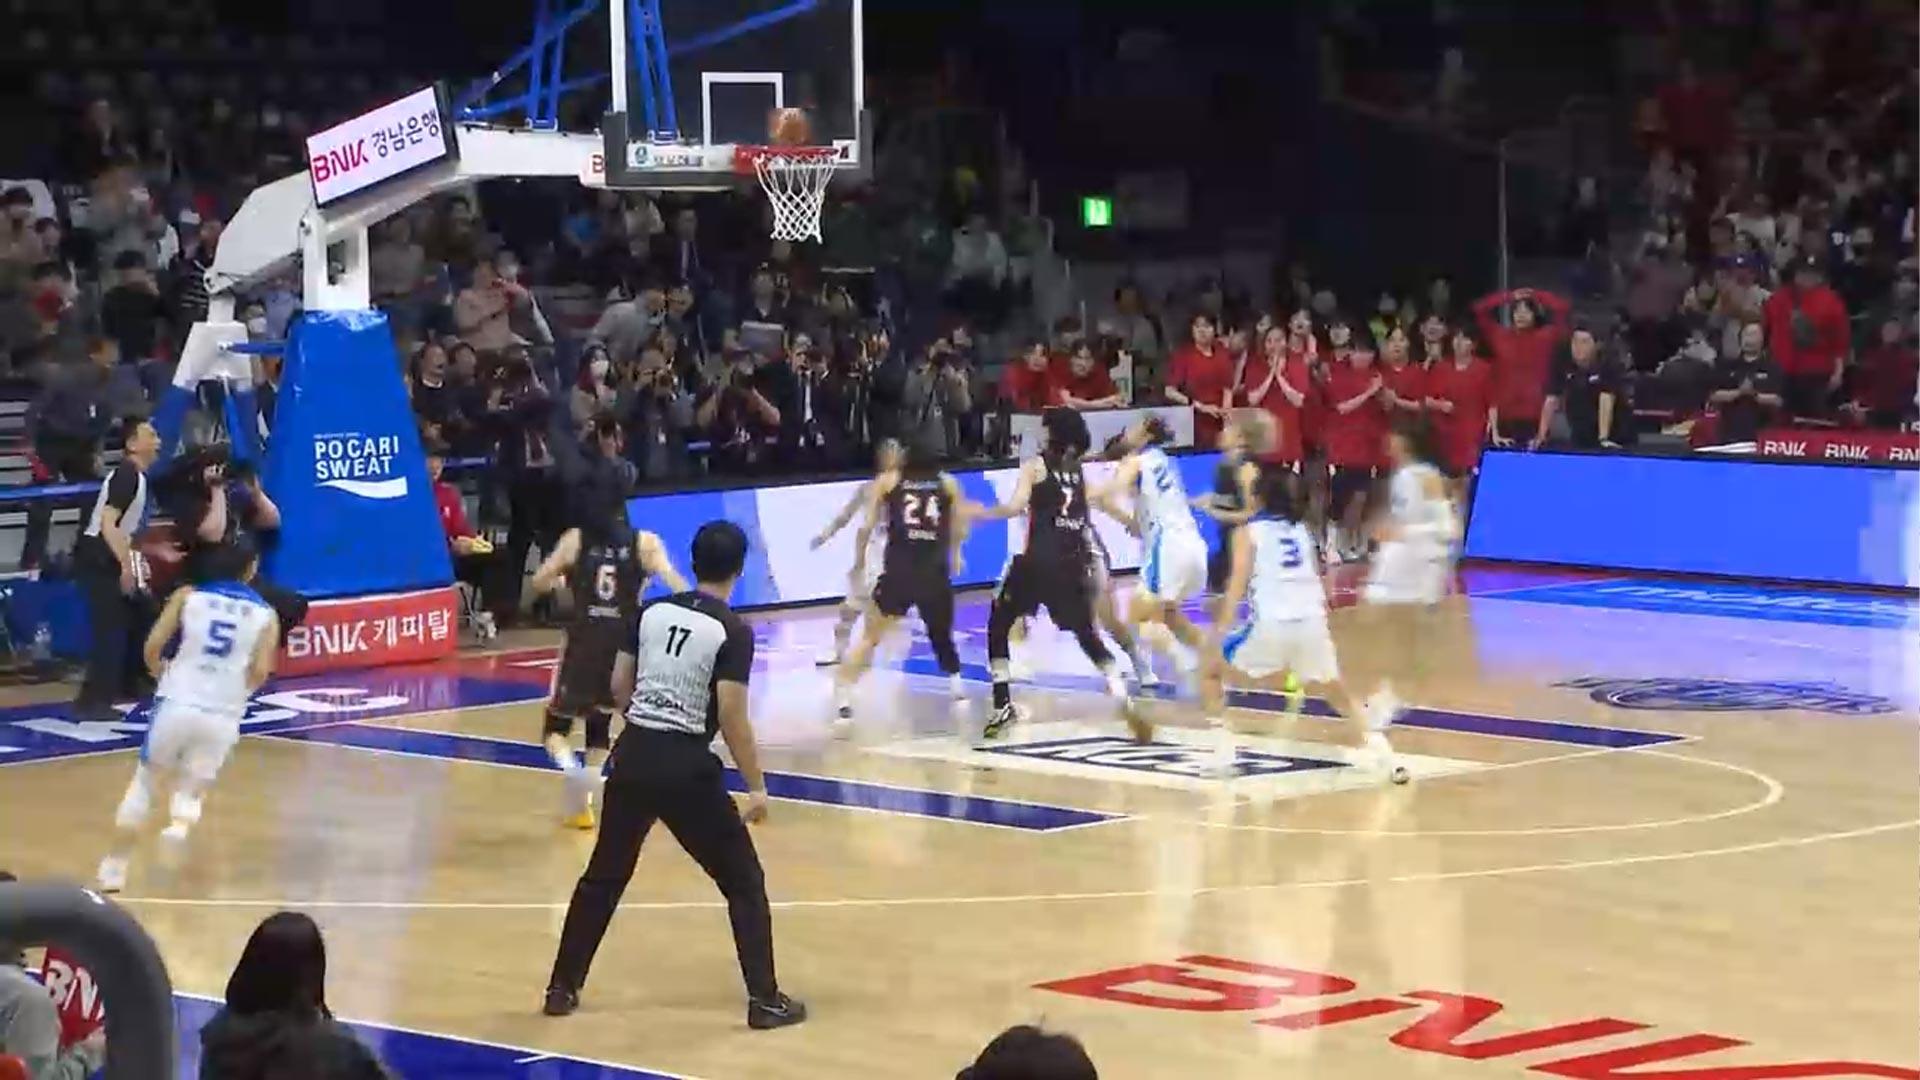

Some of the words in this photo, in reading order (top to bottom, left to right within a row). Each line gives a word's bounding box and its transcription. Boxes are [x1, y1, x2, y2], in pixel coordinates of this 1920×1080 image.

[313, 139, 368, 182] BNK
[372, 109, 439, 158] 경남은행
[315, 435, 399, 460] POCARI
[316, 456, 393, 479] SWEAT
[904, 493, 941, 526] 24
[1280, 538, 1302, 568] 3
[597, 565, 617, 600] 6
[203, 620, 236, 658] 5
[287, 620, 368, 657] BNK
[373, 608, 451, 648] 캐피탈
[665, 625, 692, 657] 17
[46, 959, 105, 1021] BN
